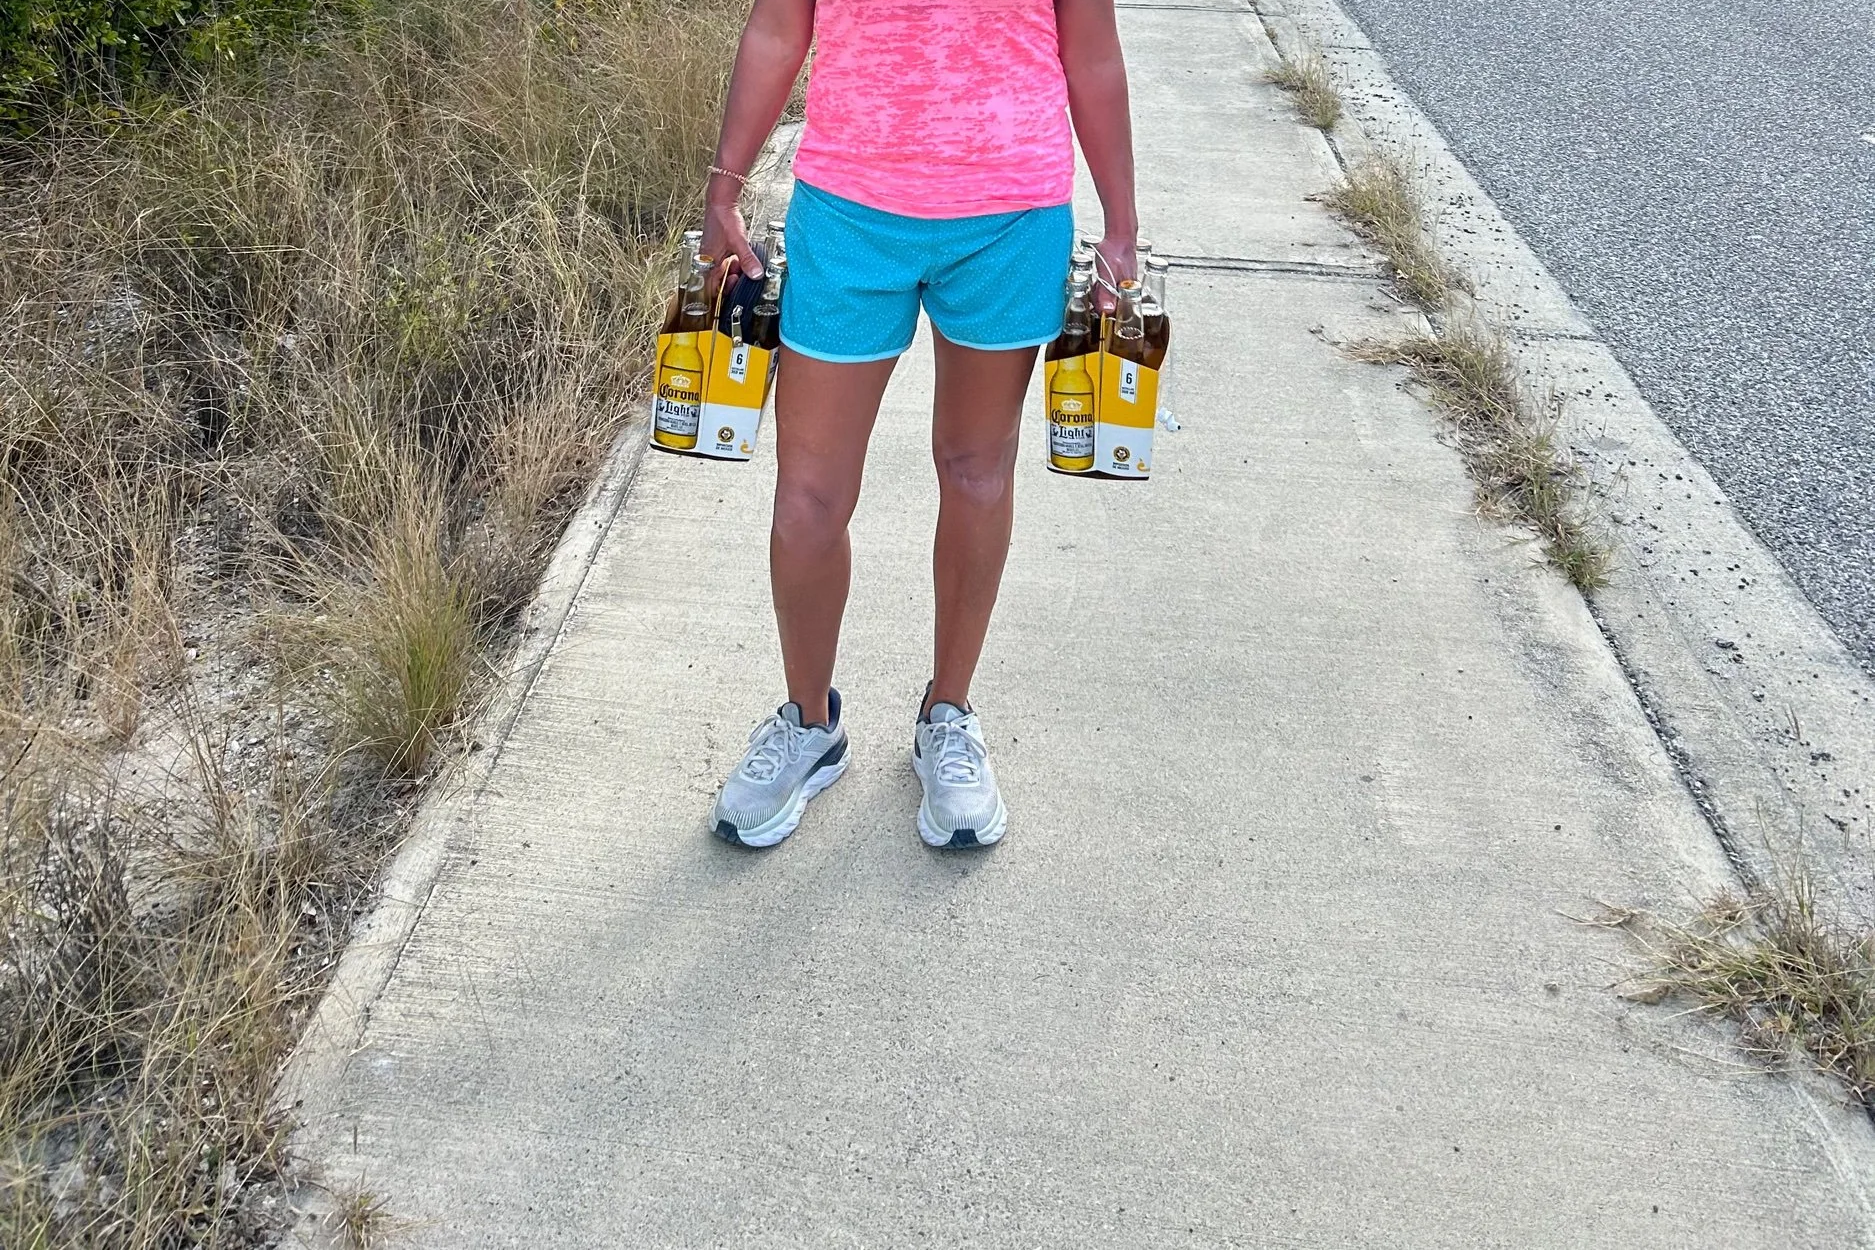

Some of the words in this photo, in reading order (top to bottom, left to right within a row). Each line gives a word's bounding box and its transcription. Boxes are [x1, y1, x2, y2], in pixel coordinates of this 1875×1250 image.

[736, 353, 743, 365] 6
[1126, 372, 1133, 385] 6
[659, 382, 700, 402] Corona
[664, 400, 690, 416] Light
[1051, 409, 1093, 425] Corona
[1058, 425, 1084, 440] Light
